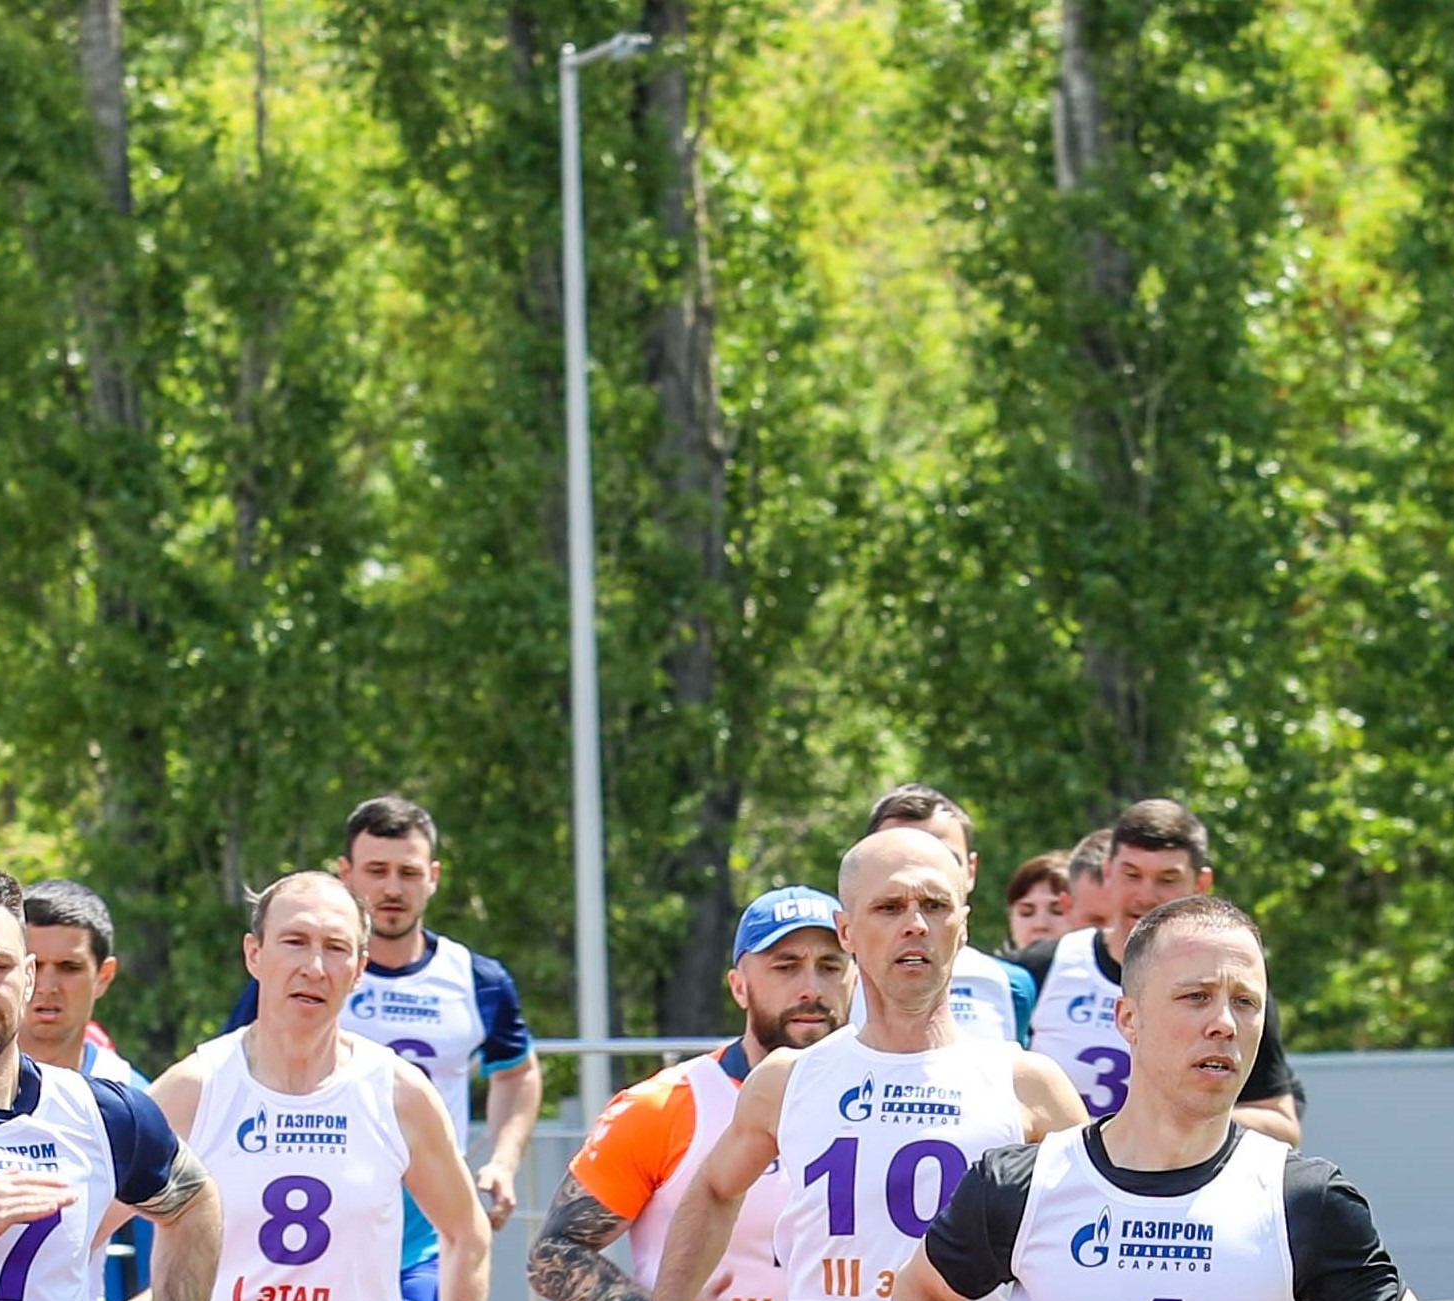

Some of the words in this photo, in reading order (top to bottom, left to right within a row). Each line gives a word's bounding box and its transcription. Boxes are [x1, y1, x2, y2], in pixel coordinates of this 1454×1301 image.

[1075, 1046, 1131, 1118] 3
[883, 1083, 962, 1100] ГАЗПРОМ
[276, 1114, 347, 1130] ГАЗПРОМ
[880, 1115, 960, 1126] САРАТОВ
[275, 1145, 347, 1154] САРАТОВ
[804, 1136, 969, 1239] 10
[258, 1175, 333, 1266] 8
[1121, 1220, 1214, 1242] ГАЗПРОМ
[1120, 1244, 1212, 1260] ТРАНСГАЗ
[1117, 1259, 1212, 1272] САРАТОВ
[823, 1258, 861, 1298] III
